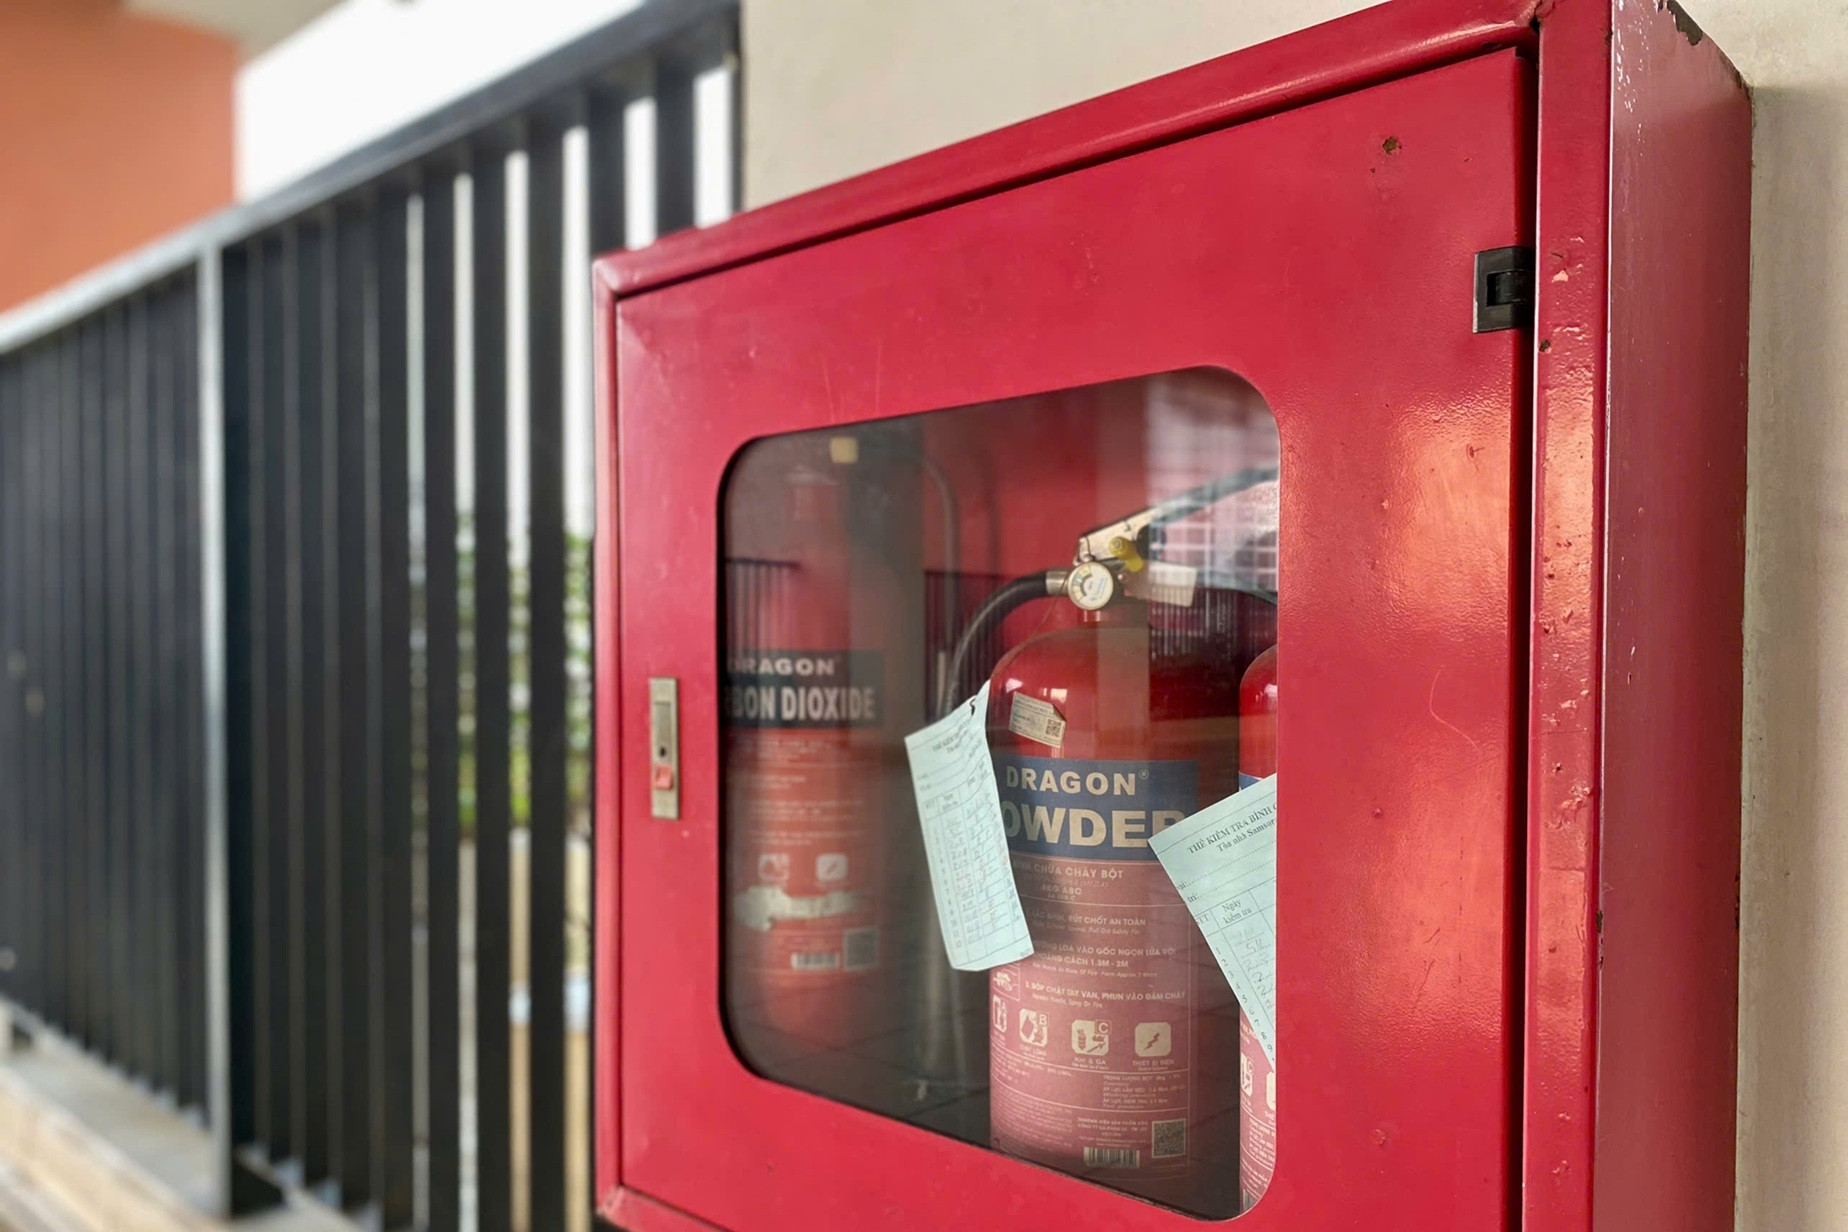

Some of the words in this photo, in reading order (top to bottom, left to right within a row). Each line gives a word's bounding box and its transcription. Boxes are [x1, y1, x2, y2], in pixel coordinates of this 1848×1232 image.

[731, 686, 776, 720] BON
[780, 686, 875, 721] DIOXIDE
[1000, 800, 1186, 848] OWDE
[1230, 820, 1249, 833] TRA
[1039, 1013, 1047, 1025] B
[1098, 1022, 1109, 1033] C
